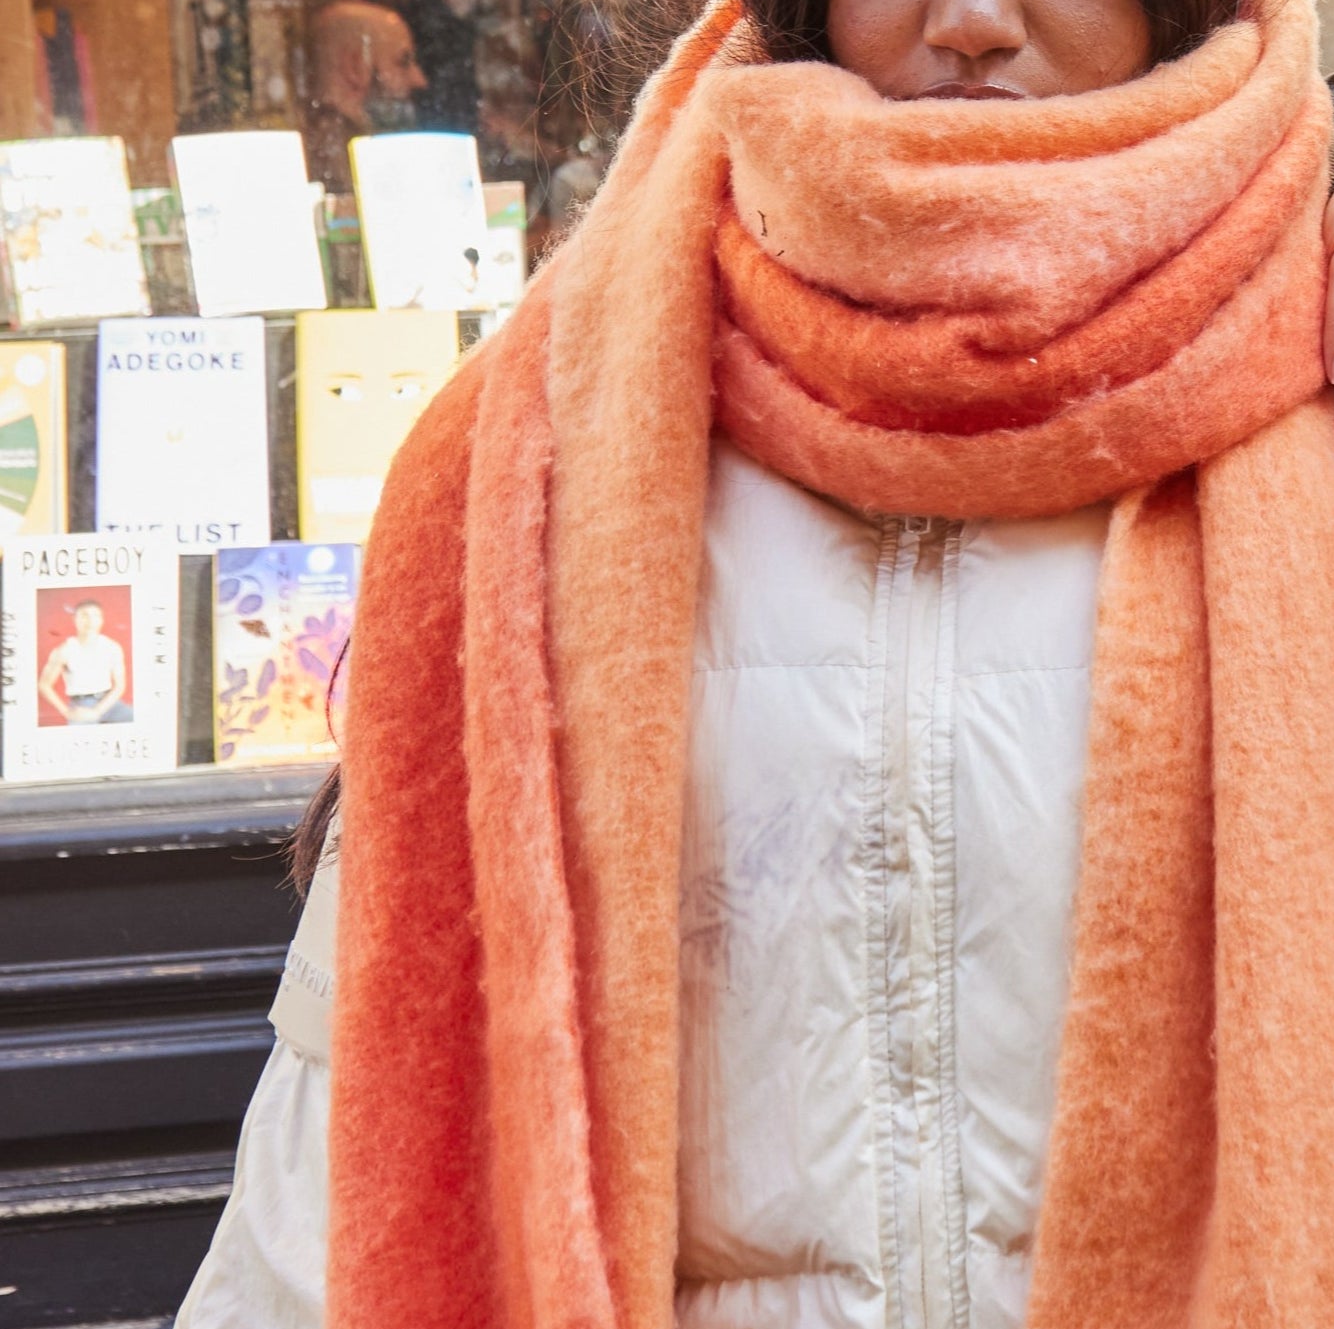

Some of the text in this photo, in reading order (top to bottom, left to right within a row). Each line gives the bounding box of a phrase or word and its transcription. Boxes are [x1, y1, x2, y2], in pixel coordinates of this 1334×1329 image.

[107, 352, 245, 371] ADEGOKE
[176, 523, 244, 544] LIST
[22, 547, 146, 576] PAGEBOY
